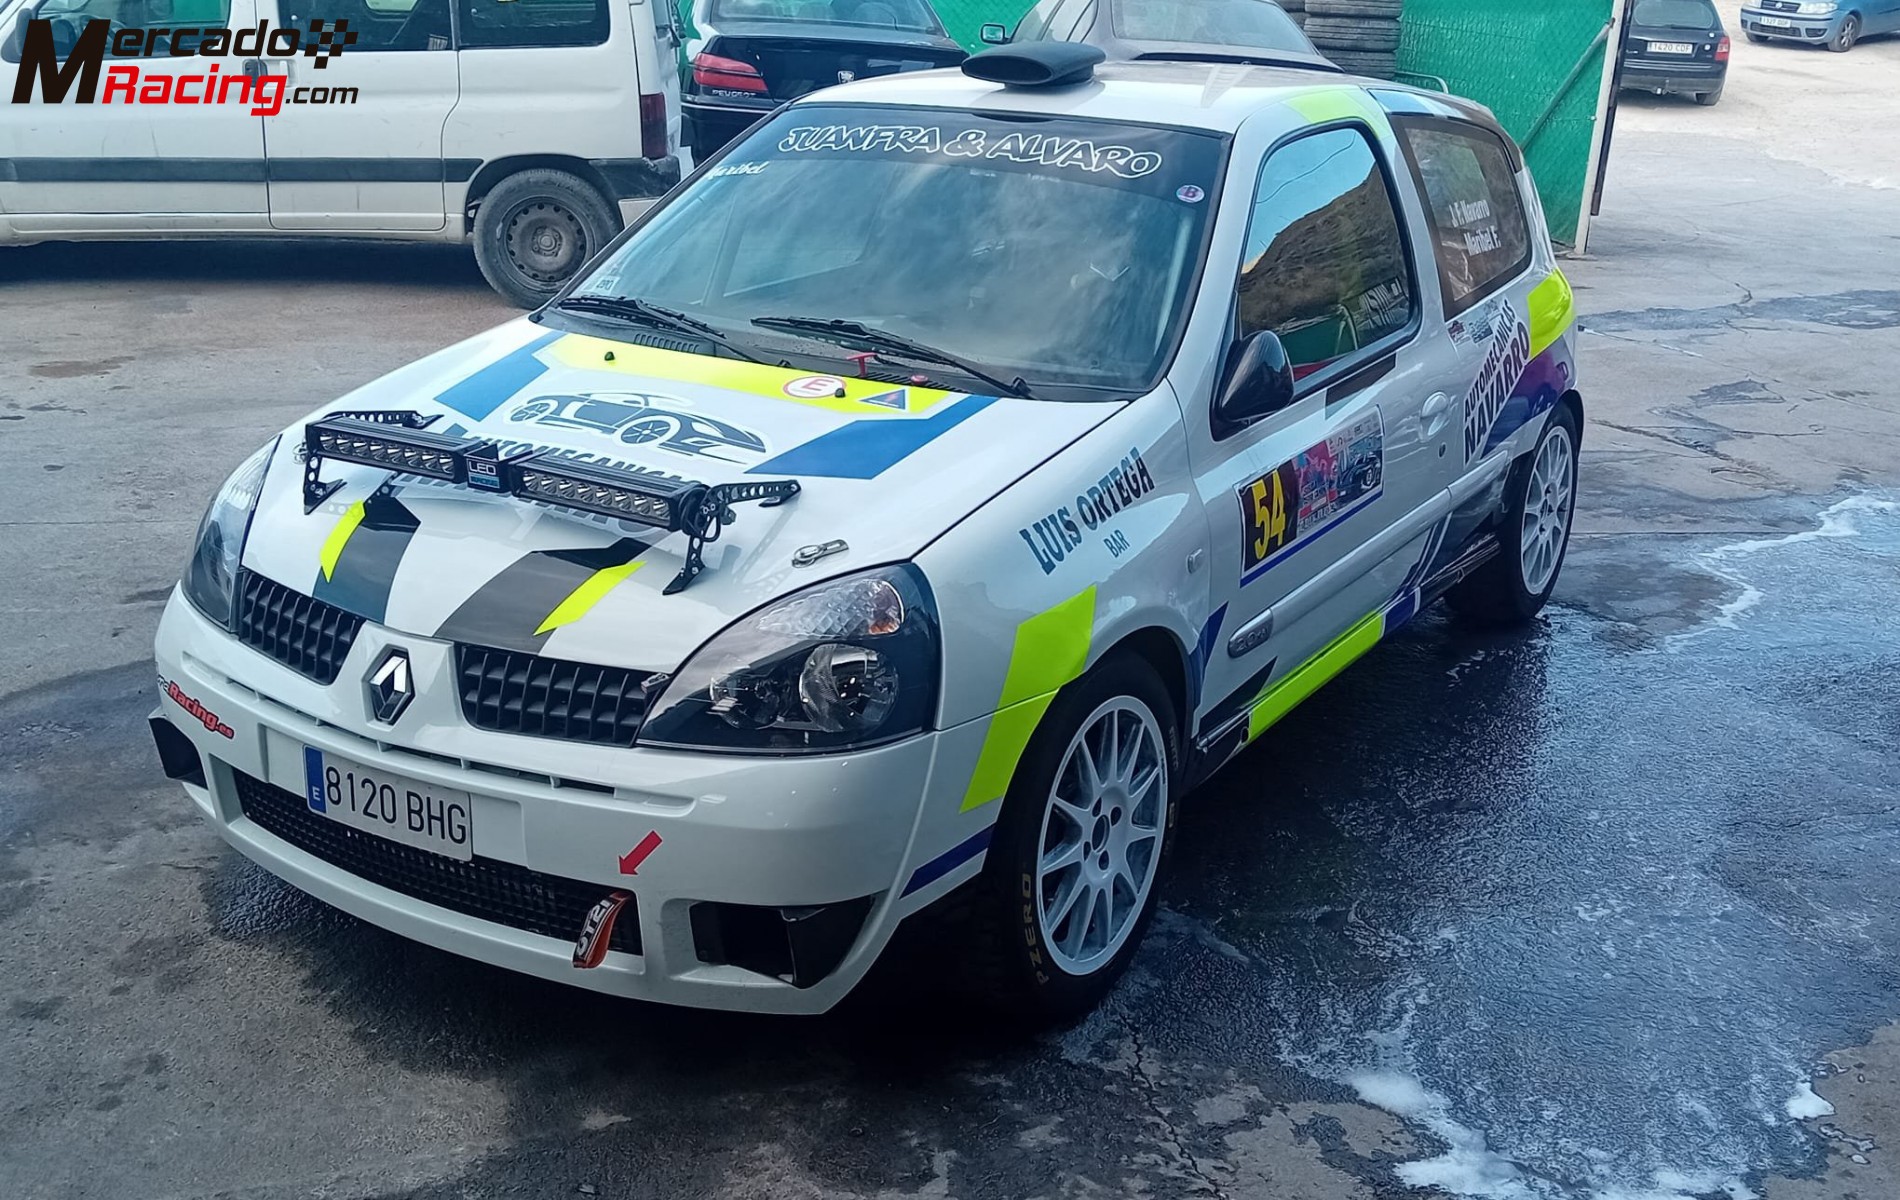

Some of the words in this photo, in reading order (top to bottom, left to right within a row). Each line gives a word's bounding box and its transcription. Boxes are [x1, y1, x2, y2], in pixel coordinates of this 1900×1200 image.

[712, 90, 756, 98] PEUGEOT
[778, 125, 941, 153] JUANFRA
[943, 130, 987, 158] &
[986, 132, 1162, 178] ALVARO
[1459, 199, 1491, 224] Navarro
[801, 378, 834, 391] E
[1464, 298, 1516, 422] AUTOMECANICAS
[1464, 321, 1530, 465] NAVARRO
[468, 460, 497, 476] LED
[1019, 506, 1082, 575] LUIS
[1076, 446, 1155, 531] ORTEGA
[1252, 468, 1286, 560] 54
[1103, 529, 1130, 558] BAR
[312, 786, 321, 801] E
[325, 766, 397, 824] 8120
[406, 790, 467, 845] BHG
